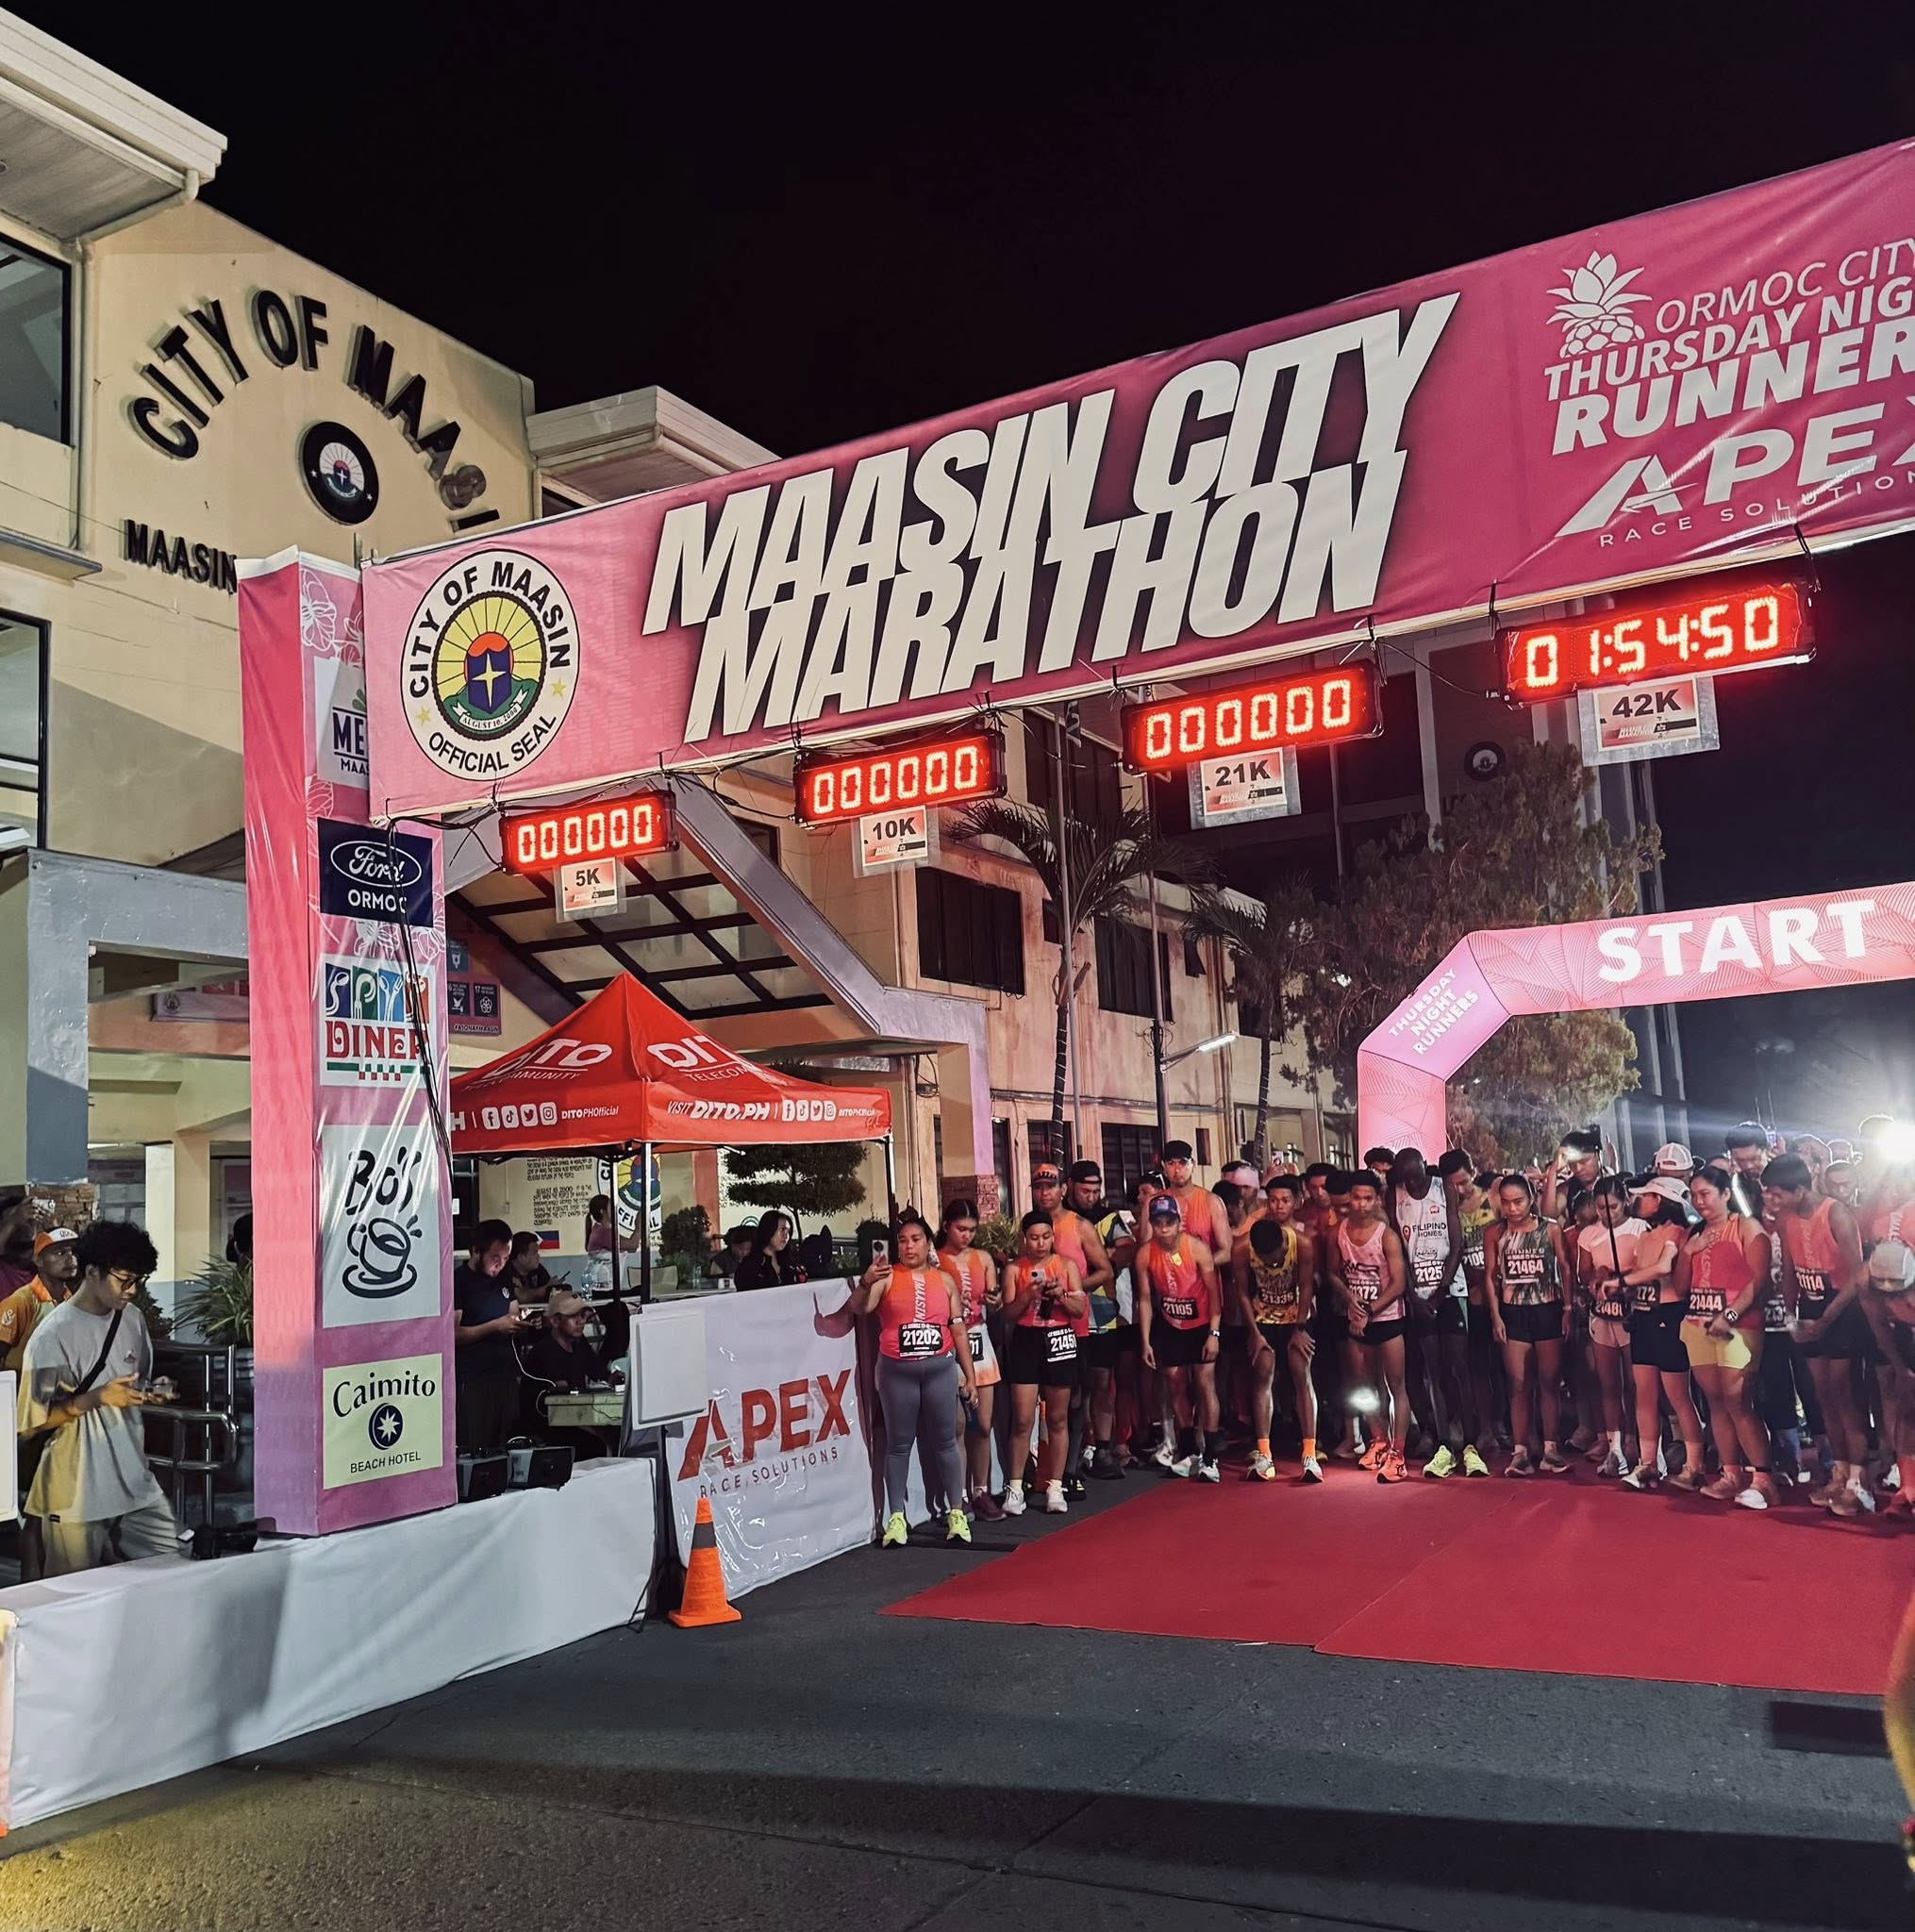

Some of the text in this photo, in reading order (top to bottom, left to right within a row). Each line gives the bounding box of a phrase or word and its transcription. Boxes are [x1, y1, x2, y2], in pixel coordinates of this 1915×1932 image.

[1655, 262, 1826, 333] ORMOC
[127, 299, 249, 460] CITY
[252, 290, 329, 371] OF
[1544, 302, 1807, 401] THURSDAY
[642, 291, 1460, 636] MAASIN CITY
[1599, 516, 1691, 548] RACE
[124, 519, 238, 595] MAASIN
[685, 450, 1407, 744] MARATHON
[409, 561, 571, 698] CITY OF MAASIN
[1146, 679, 1351, 759] 000000
[1611, 689, 1683, 719] 42K
[333, 712, 365, 756] ME
[429, 714, 558, 774] OFFICIAL SEAL
[813, 745, 977, 814] 000000
[1215, 759, 1271, 787] 21K
[518, 804, 653, 863] 000000
[873, 816, 916, 841] 10K
[575, 867, 601, 887] 5K
[1598, 899, 1877, 983] START
[1389, 968, 1457, 1037] THURSDAY
[1410, 988, 1457, 1037] NIGHT
[1413, 990, 1479, 1055] RUNNERS
[561, 1106, 619, 1120] DITOPHOfficial
[667, 1100, 771, 1121] VISIT DITO.PH
[1412, 1223, 1447, 1233] FILIPINO
[1415, 1266, 1445, 1283] 2125
[1507, 1259, 1544, 1274] 21464
[1163, 1302, 1192, 1316] 21105
[1690, 1294, 1723, 1311] 21444
[903, 1329, 941, 1346] 21202
[333, 1369, 436, 1418] Caimito
[677, 1369, 851, 1482] APEX
[350, 1452, 422, 1474] BEACH HOTEL
[700, 1446, 839, 1498] RACE SOLUTIONS
